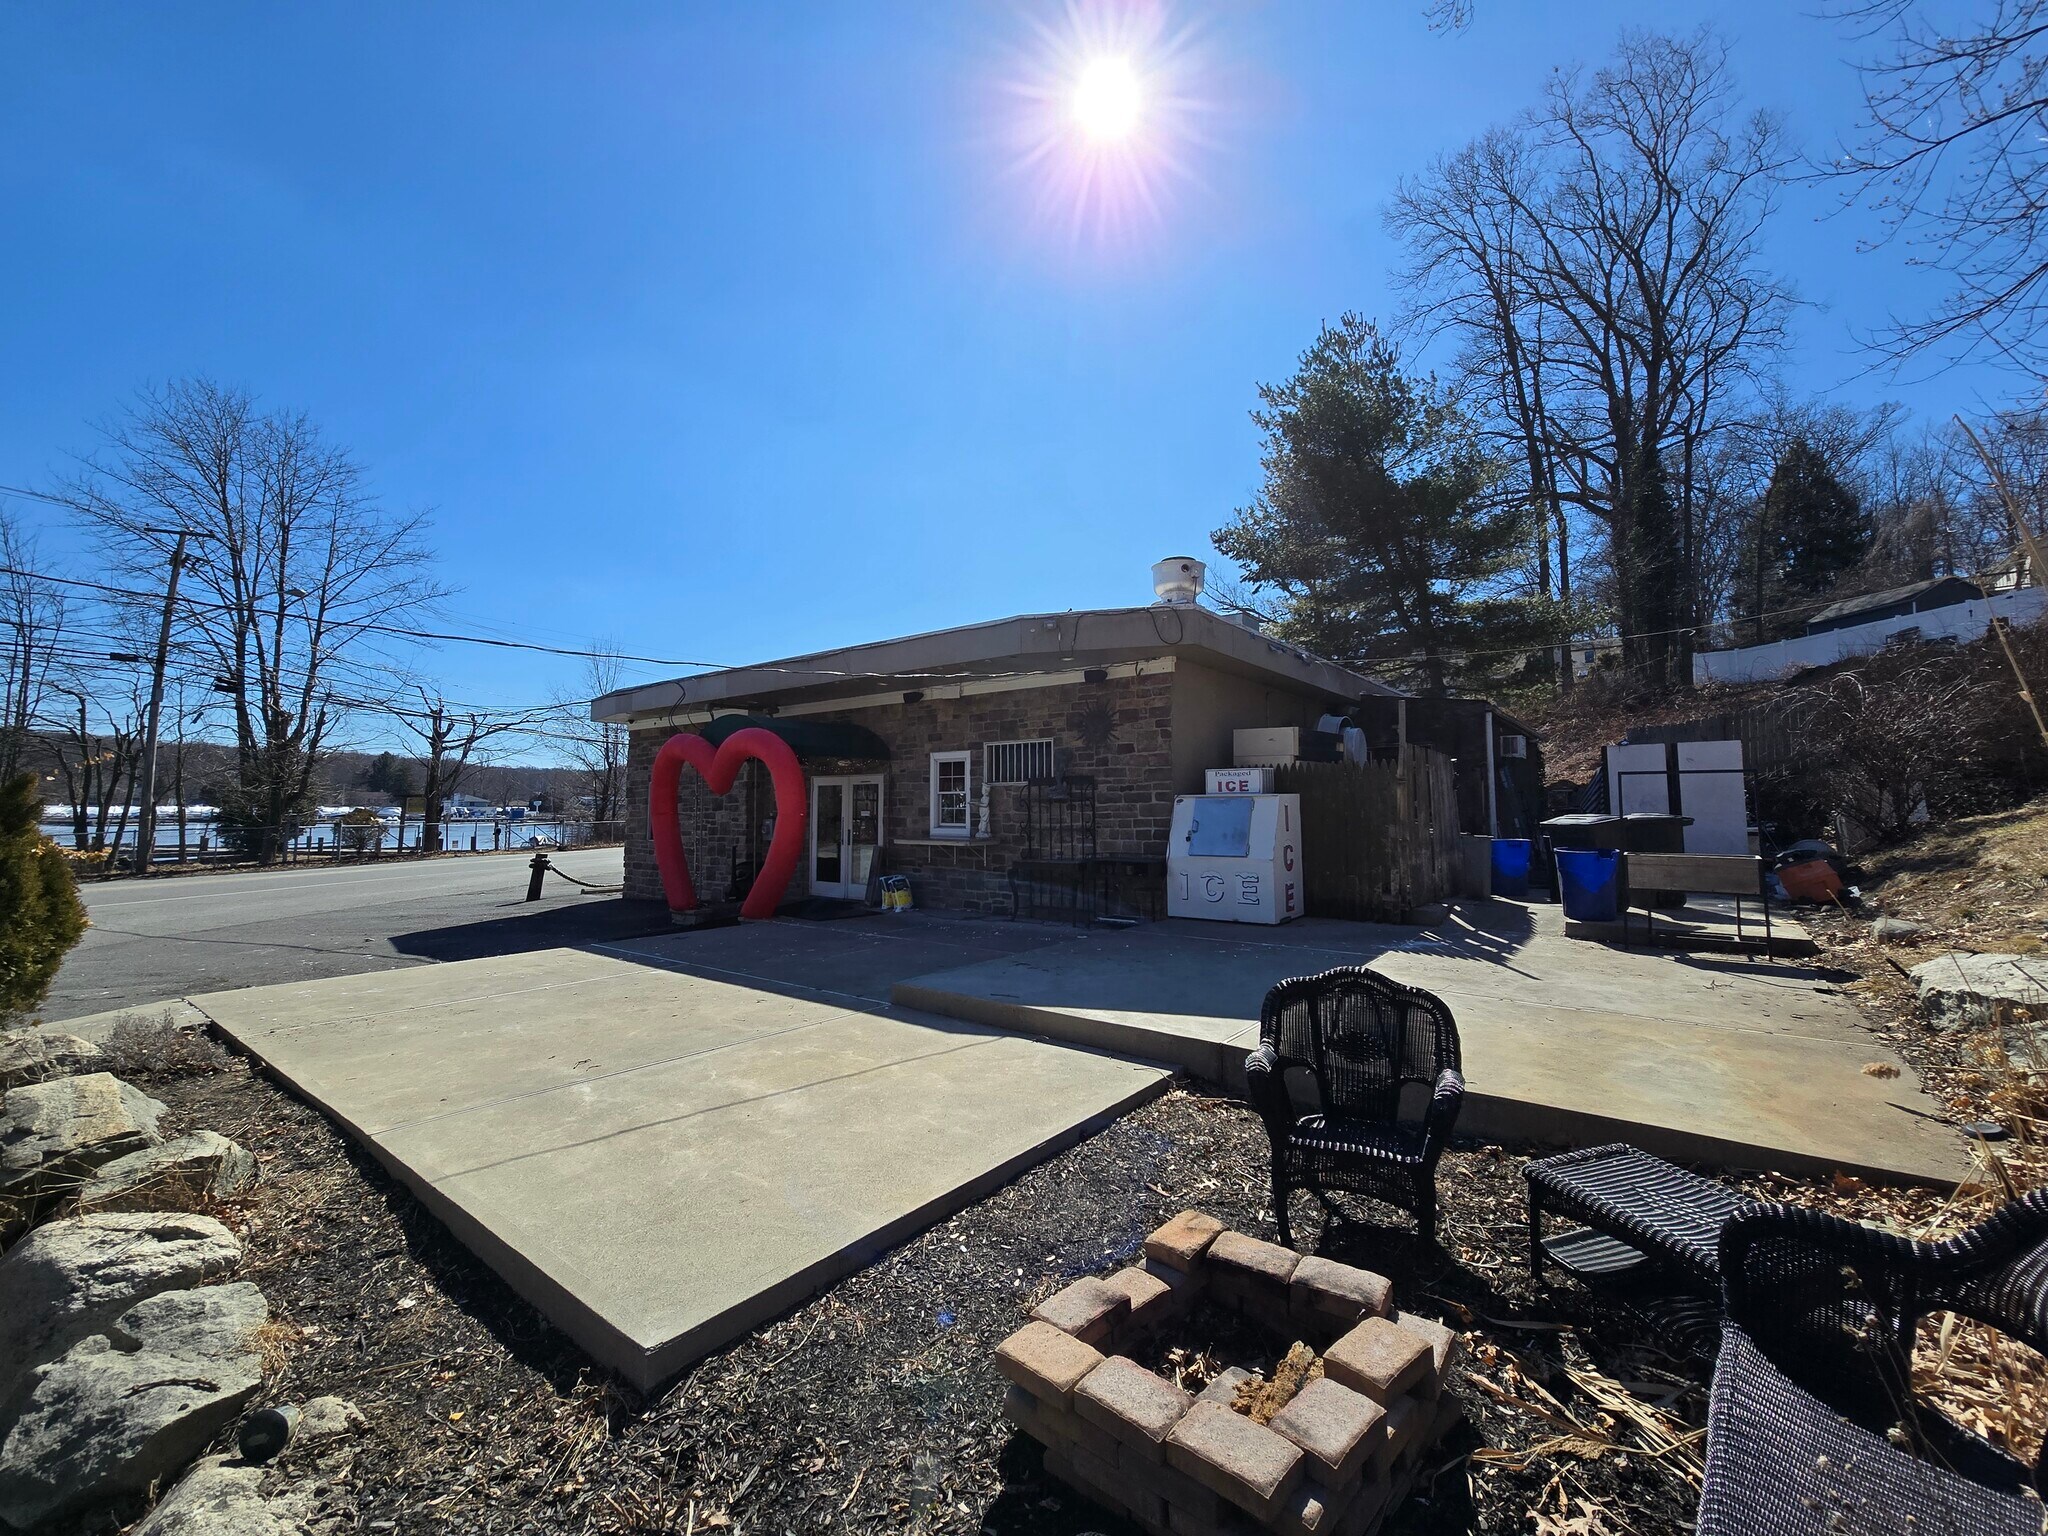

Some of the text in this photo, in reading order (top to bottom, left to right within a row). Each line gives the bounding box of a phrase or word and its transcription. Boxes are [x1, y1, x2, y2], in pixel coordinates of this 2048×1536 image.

[1217, 780, 1249, 792] ICE
[1284, 803, 1295, 913] ICE
[1179, 870, 1260, 905] ICE
